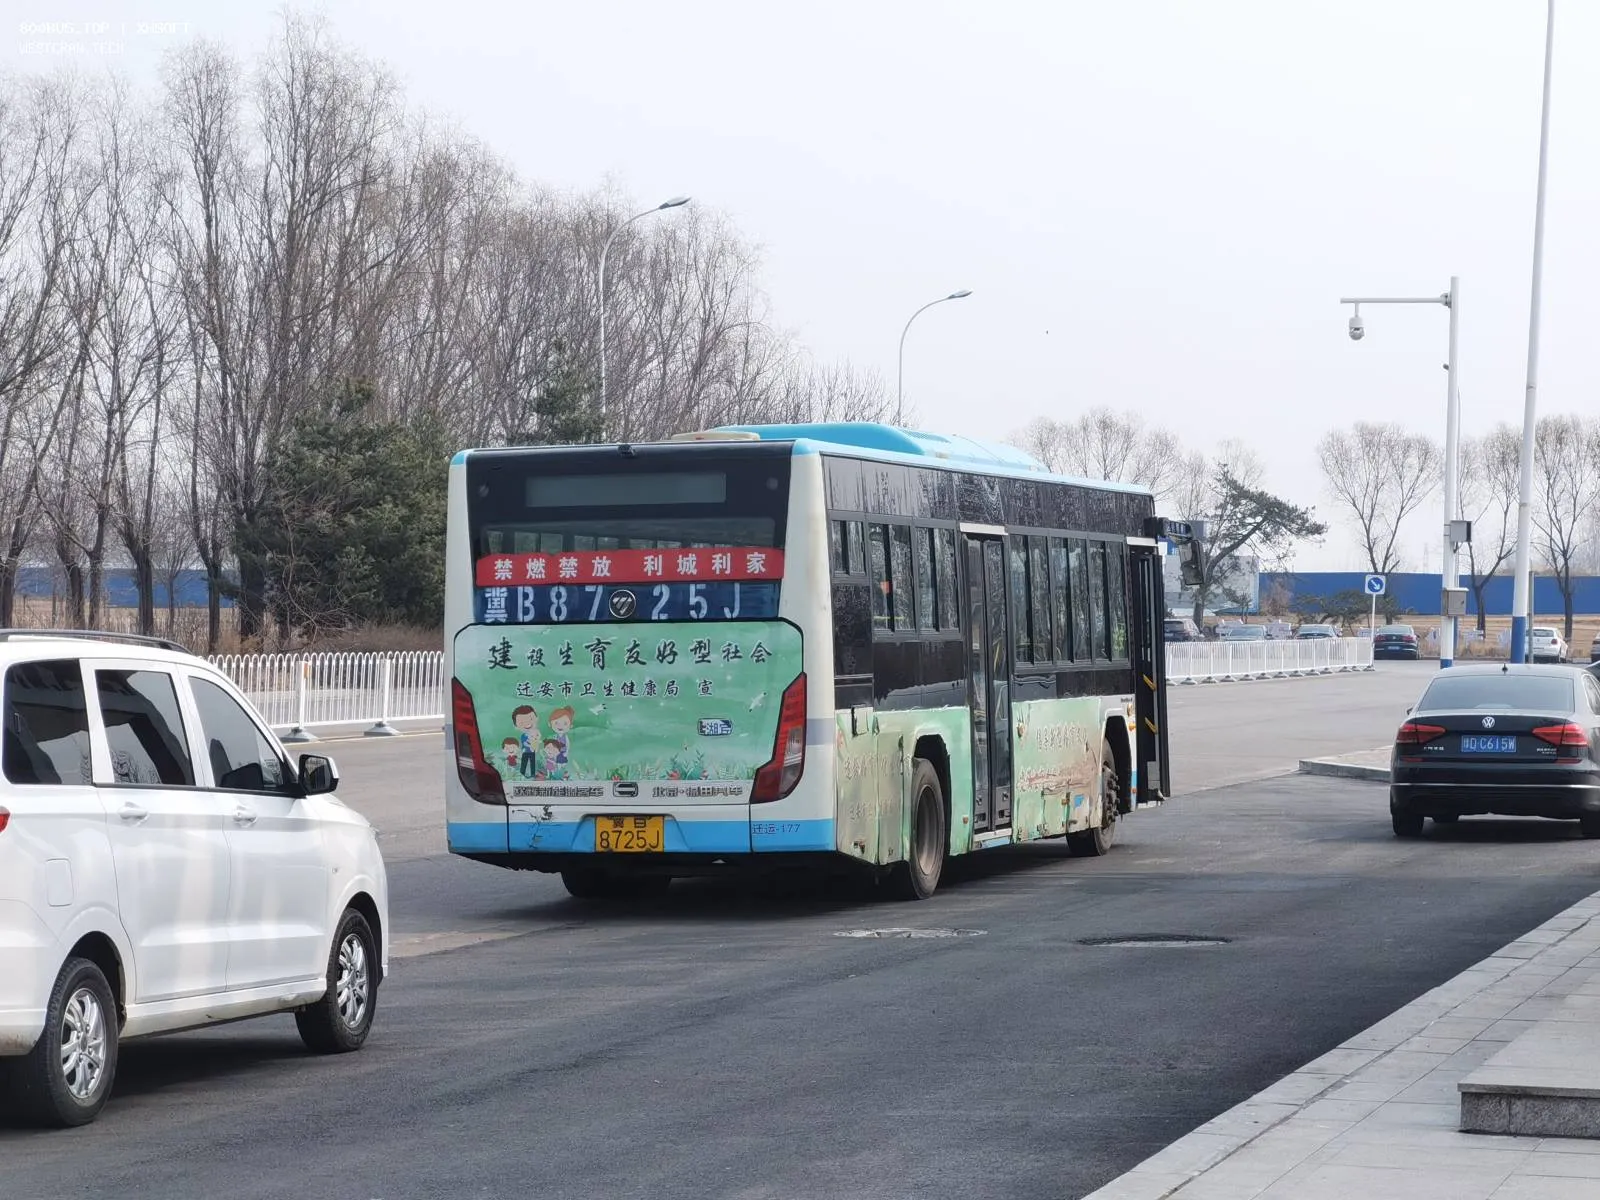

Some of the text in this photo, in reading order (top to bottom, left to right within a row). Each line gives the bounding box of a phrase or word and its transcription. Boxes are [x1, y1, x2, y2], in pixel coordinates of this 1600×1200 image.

[494, 551, 768, 581] 禁燃禁放 利城利家
[487, 636, 773, 671] 建设生育友好型社会
[516, 680, 715, 698] 迁安市卫生健康局 宣
[599, 829, 661, 850] 8725J
